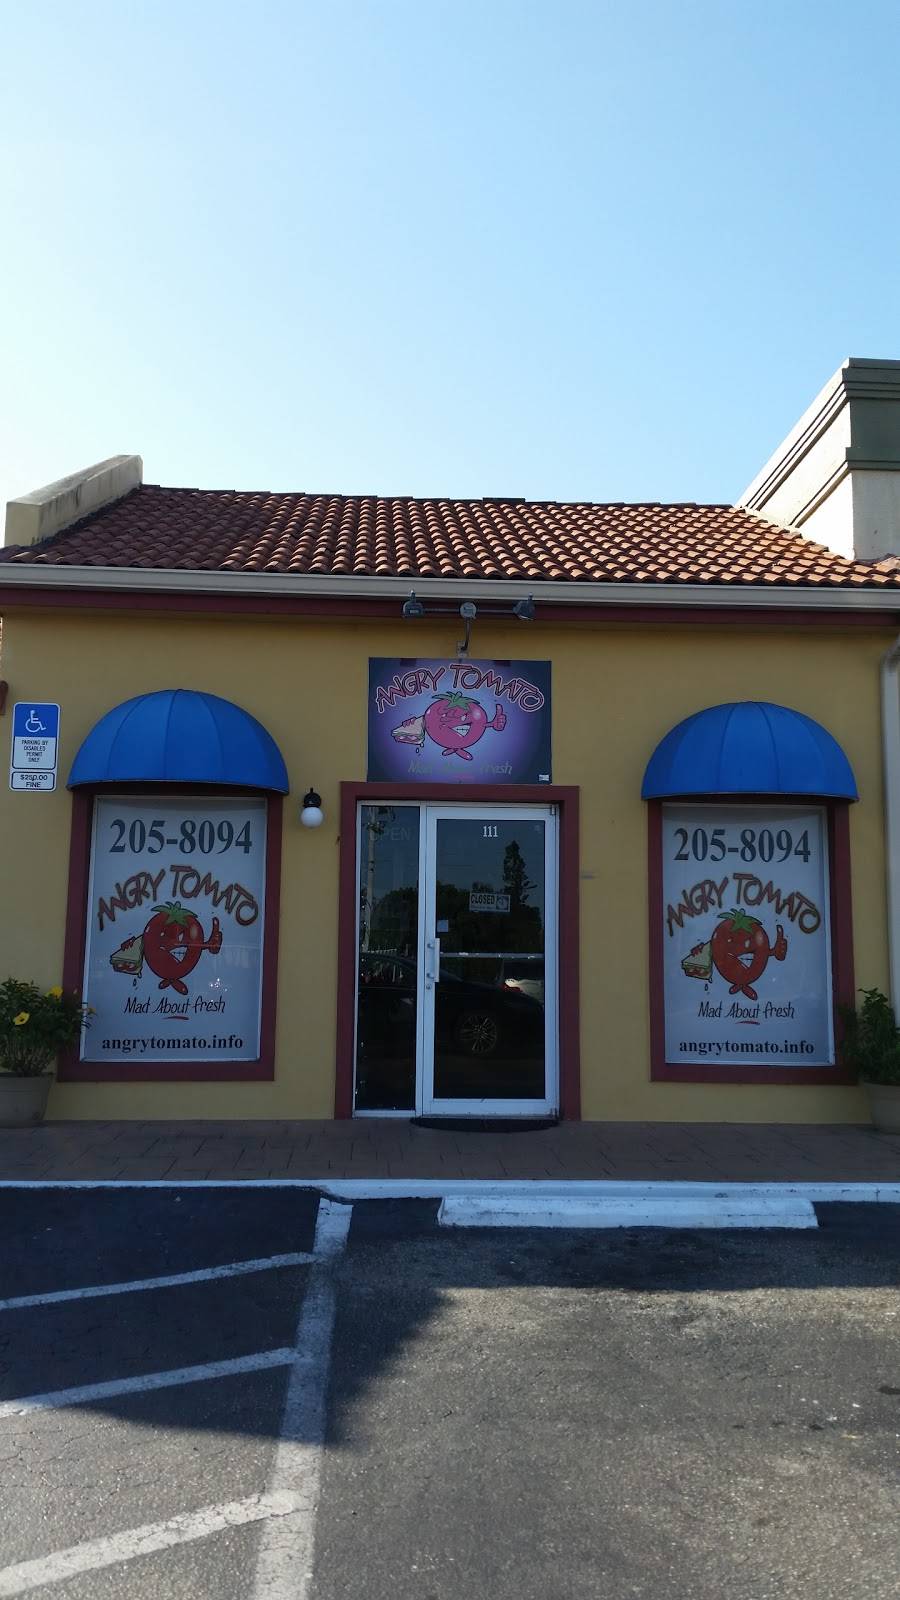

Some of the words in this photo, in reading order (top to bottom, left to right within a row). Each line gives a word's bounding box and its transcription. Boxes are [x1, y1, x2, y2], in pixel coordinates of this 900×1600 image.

[375, 666, 446, 714] ANGRY
[449, 664, 545, 713] TOMATO
[109, 818, 253, 854] 205-8094
[482, 825, 499, 838] 111
[673, 827, 811, 863] 205-8094
[97, 868, 166, 931] ANGRY
[169, 864, 259, 926] TOMATO
[470, 894, 496, 905] CLOSED
[666, 876, 729, 937] ANGRY
[732, 872, 822, 935] TOMATO
[123, 996, 151, 1014] Mad
[152, 996, 191, 1014] About
[697, 1000, 723, 1018] Mad
[724, 1001, 761, 1018] About
[101, 1034, 244, 1053] angrytomato.info
[678, 1040, 815, 1056] angrytomato.info
